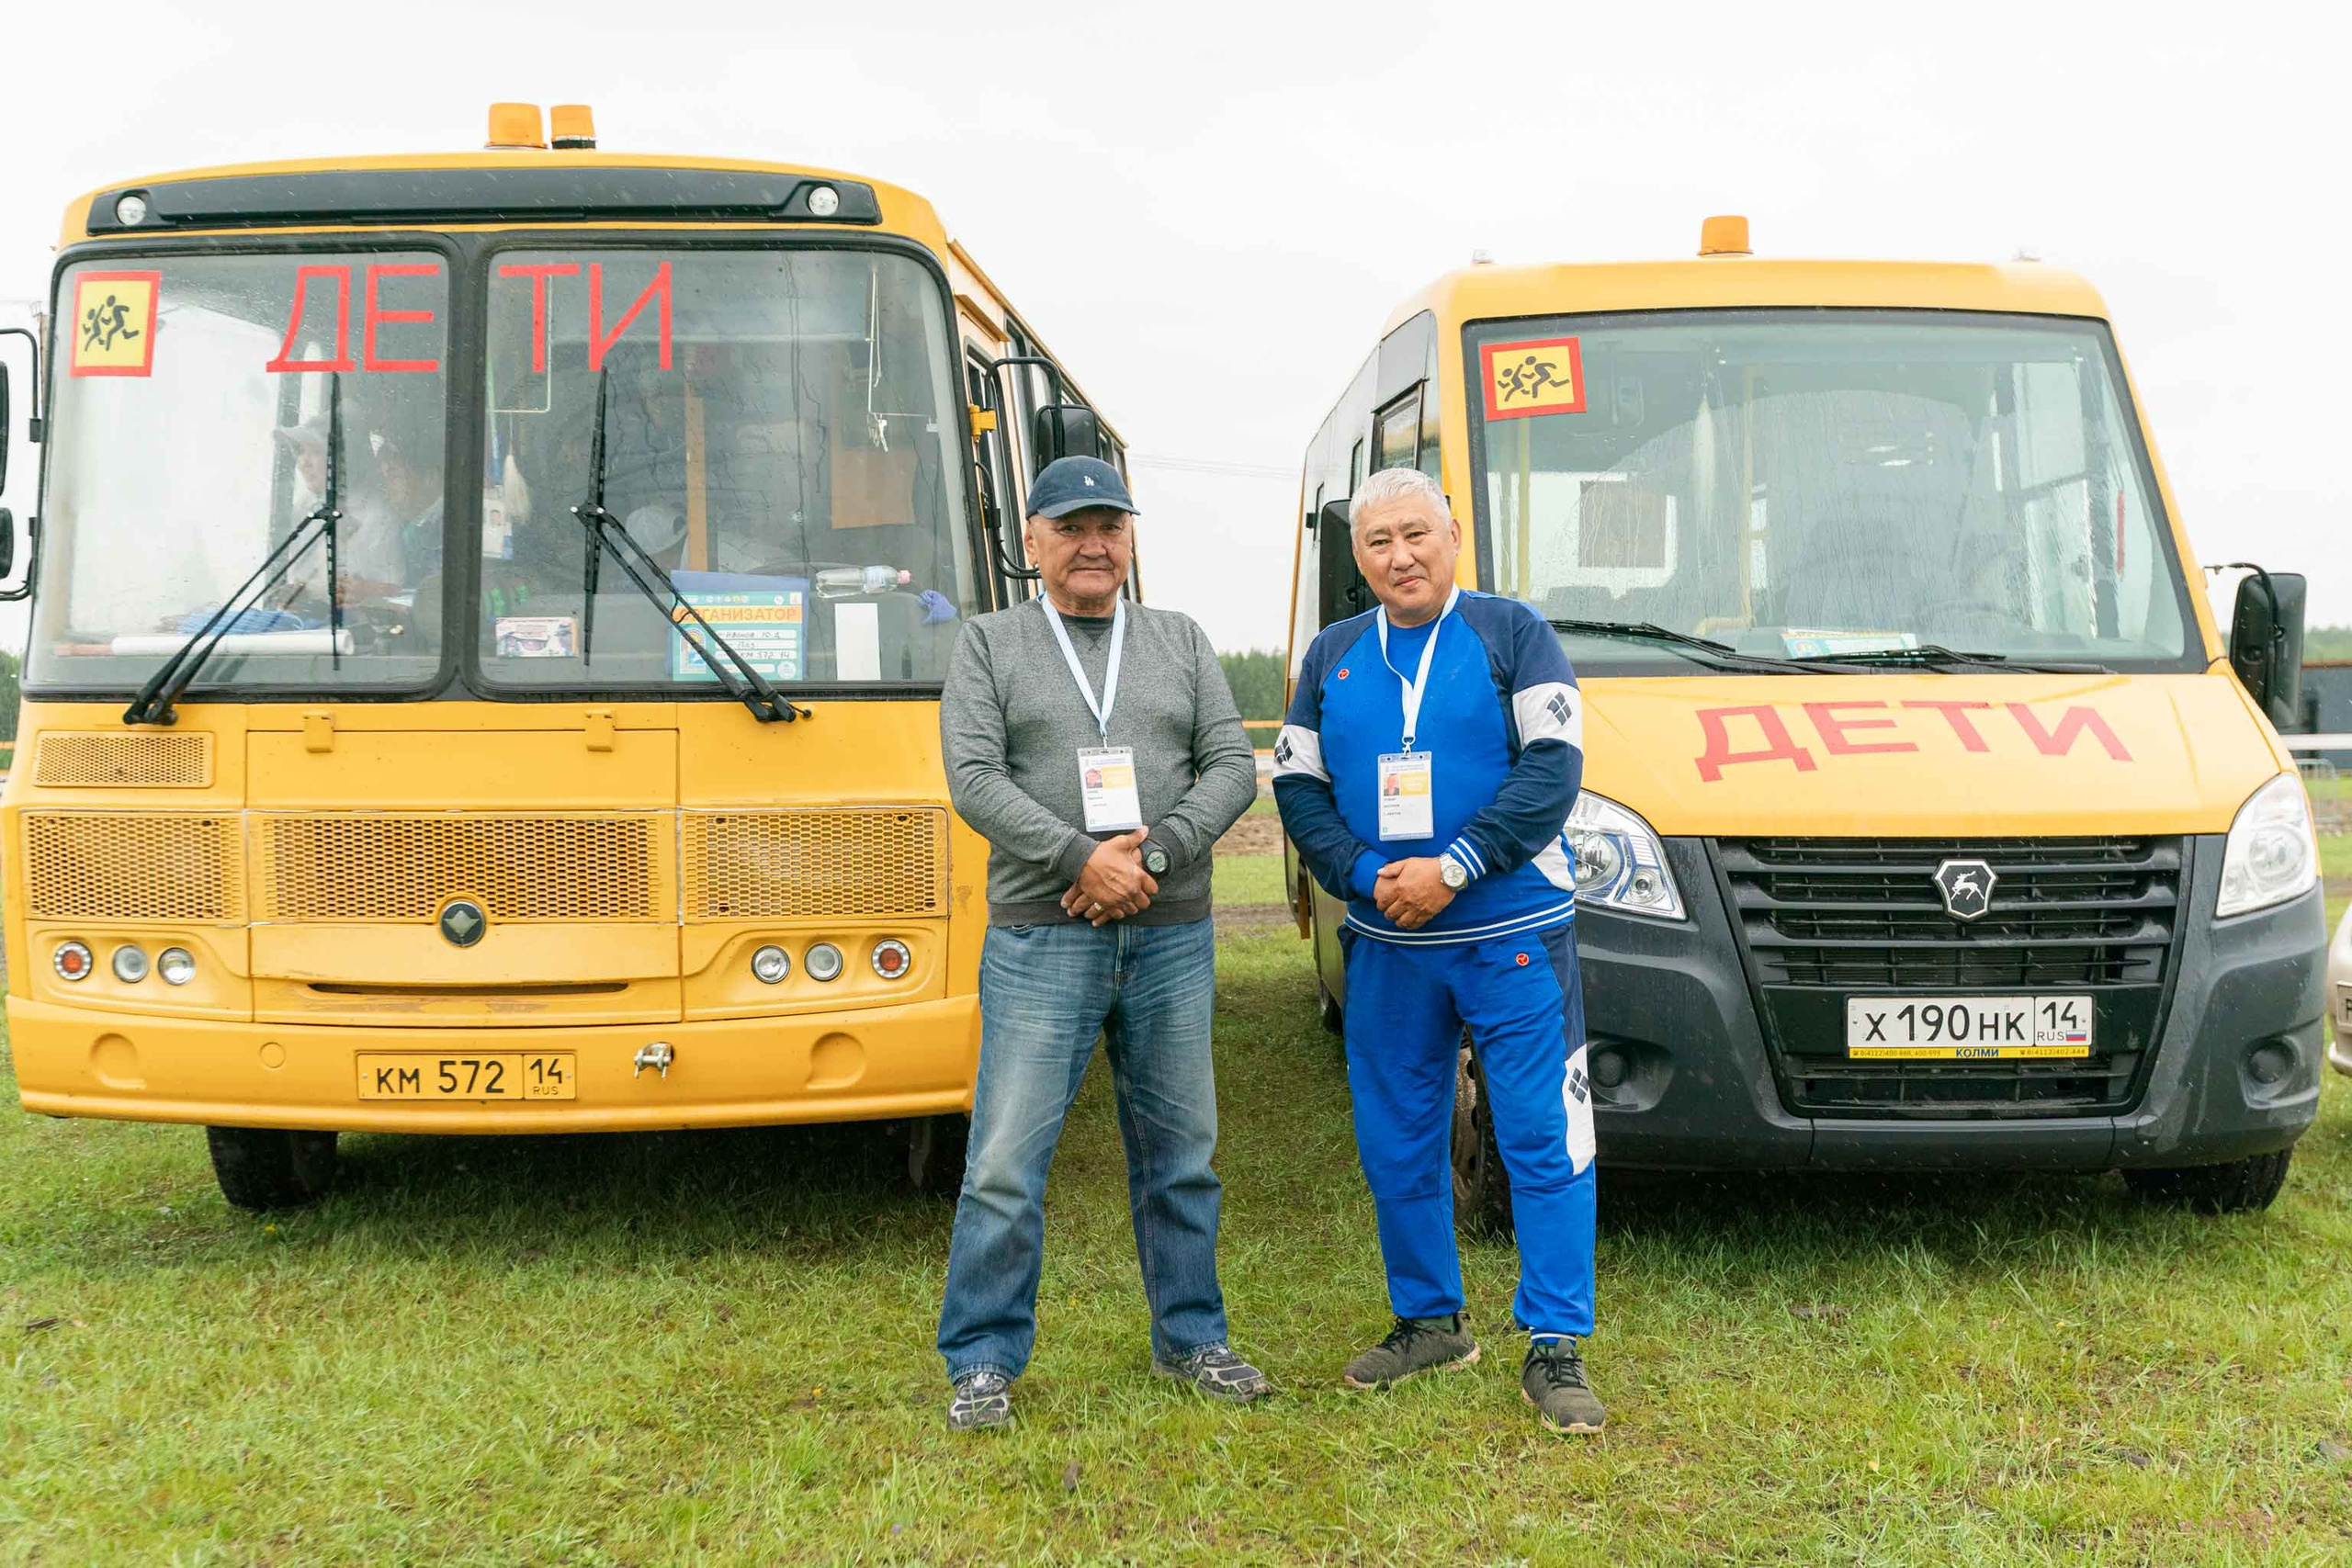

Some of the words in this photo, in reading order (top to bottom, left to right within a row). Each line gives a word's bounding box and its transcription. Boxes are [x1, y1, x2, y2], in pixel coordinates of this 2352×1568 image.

[266, 262, 673, 373] ДЕТИ
[1694, 700, 2133, 783] ДЕТИ
[2042, 1001, 2077, 1030] 14
[2037, 1031, 2064, 1042] RUS
[1956, 1048, 1999, 1057] КОЛМИ
[377, 1068, 420, 1093] КМ
[438, 1060, 504, 1094] 572
[529, 1058, 563, 1084] 14
[533, 1086, 559, 1096] RUS
